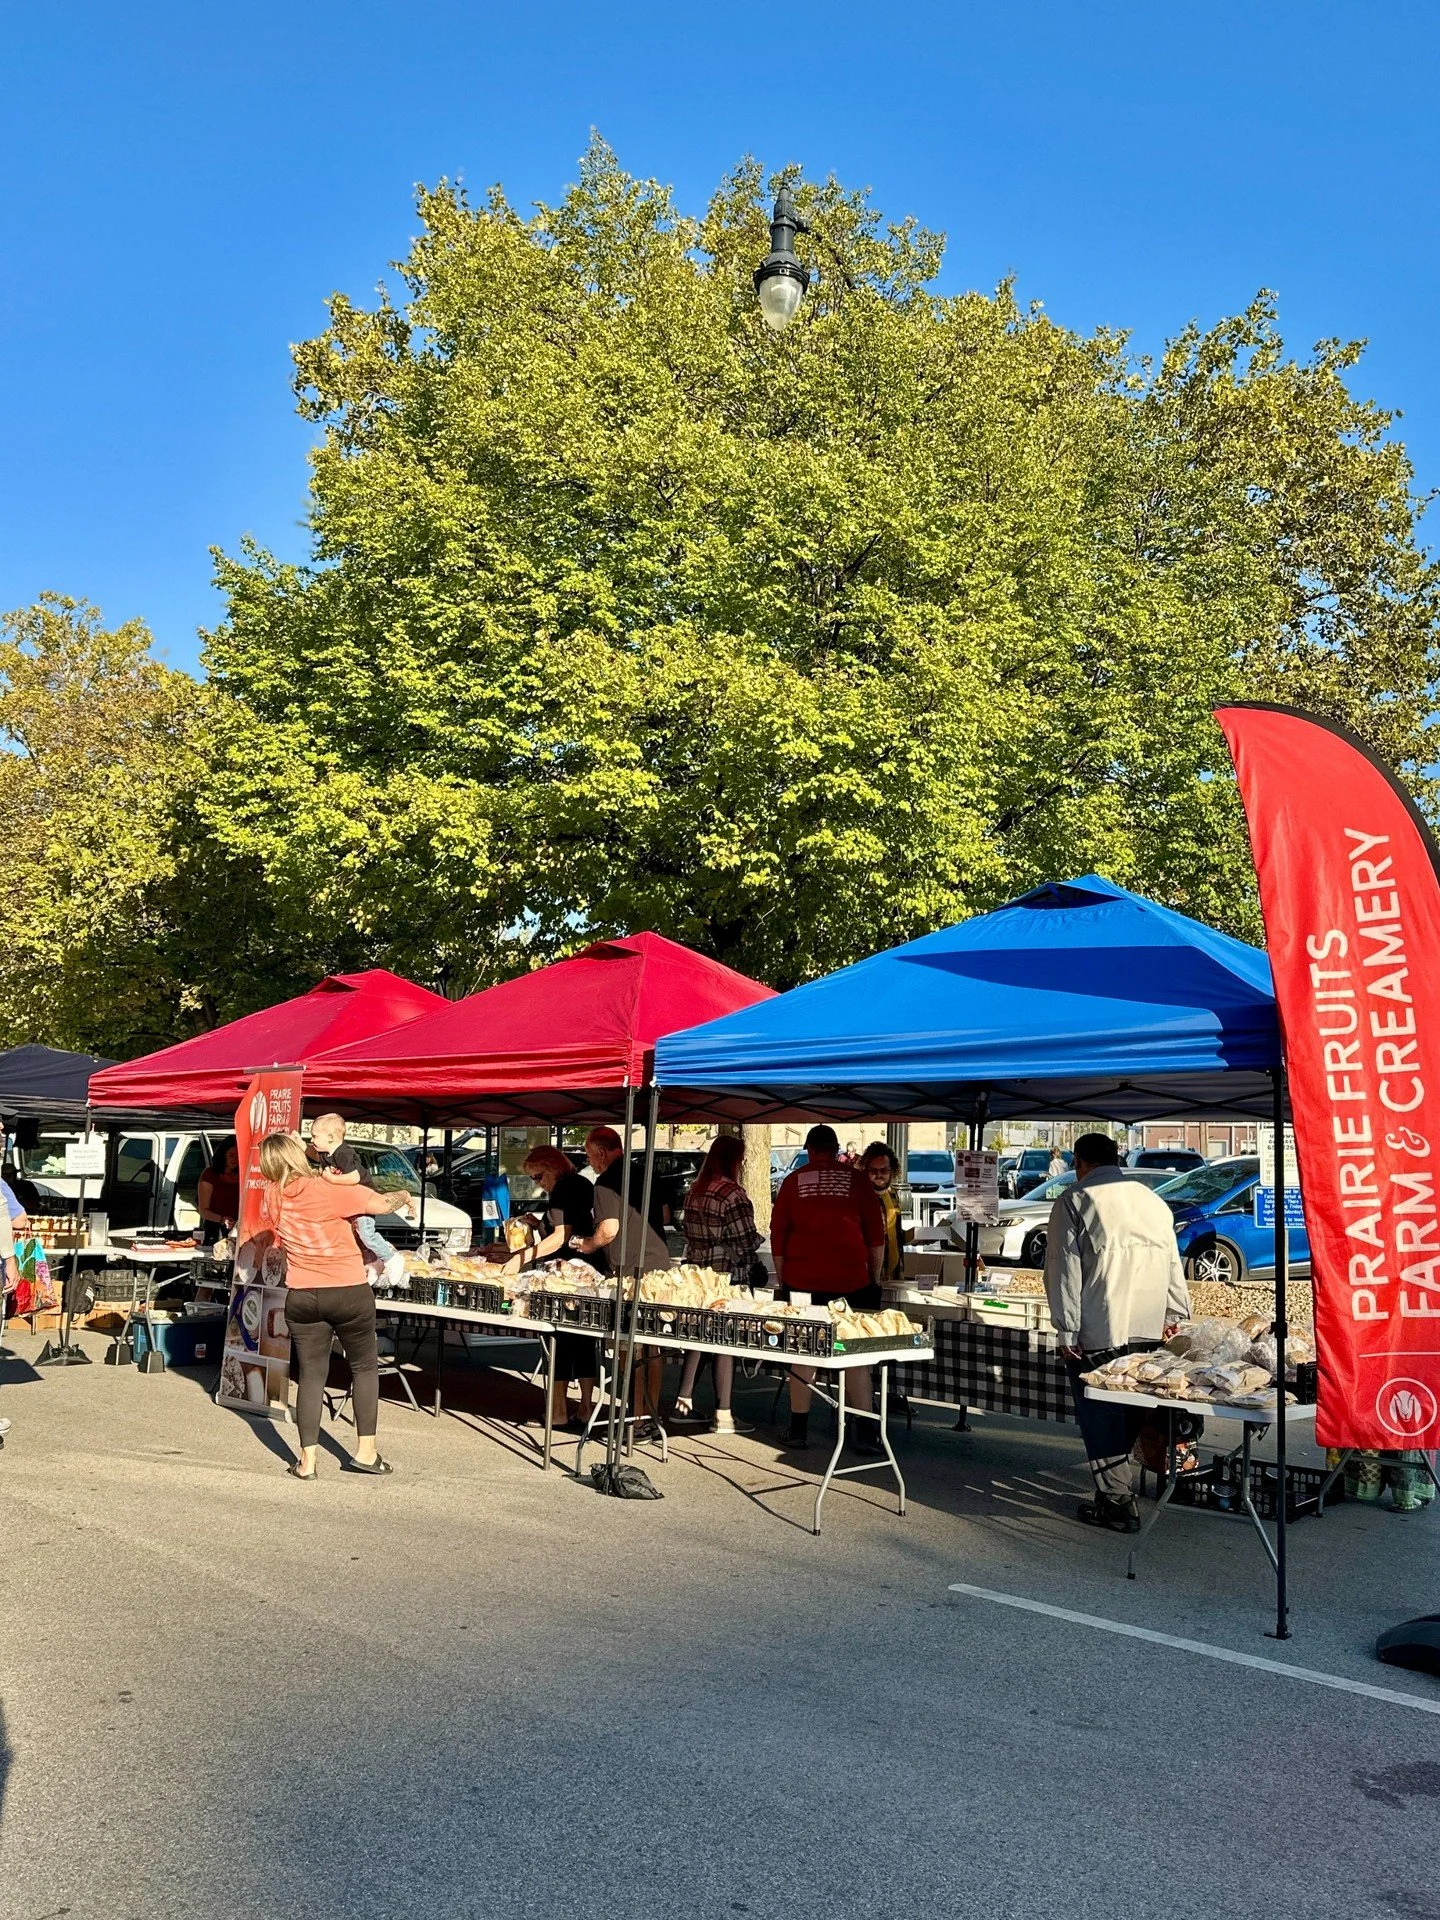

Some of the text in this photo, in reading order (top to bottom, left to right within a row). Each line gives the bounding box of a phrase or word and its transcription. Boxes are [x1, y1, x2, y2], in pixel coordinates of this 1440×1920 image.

[268, 1113, 286, 1125] FARM
[1306, 928, 1390, 1322] PRAIRIE FRUITS
[1343, 826, 1440, 1319] FARM & CREAMERY
